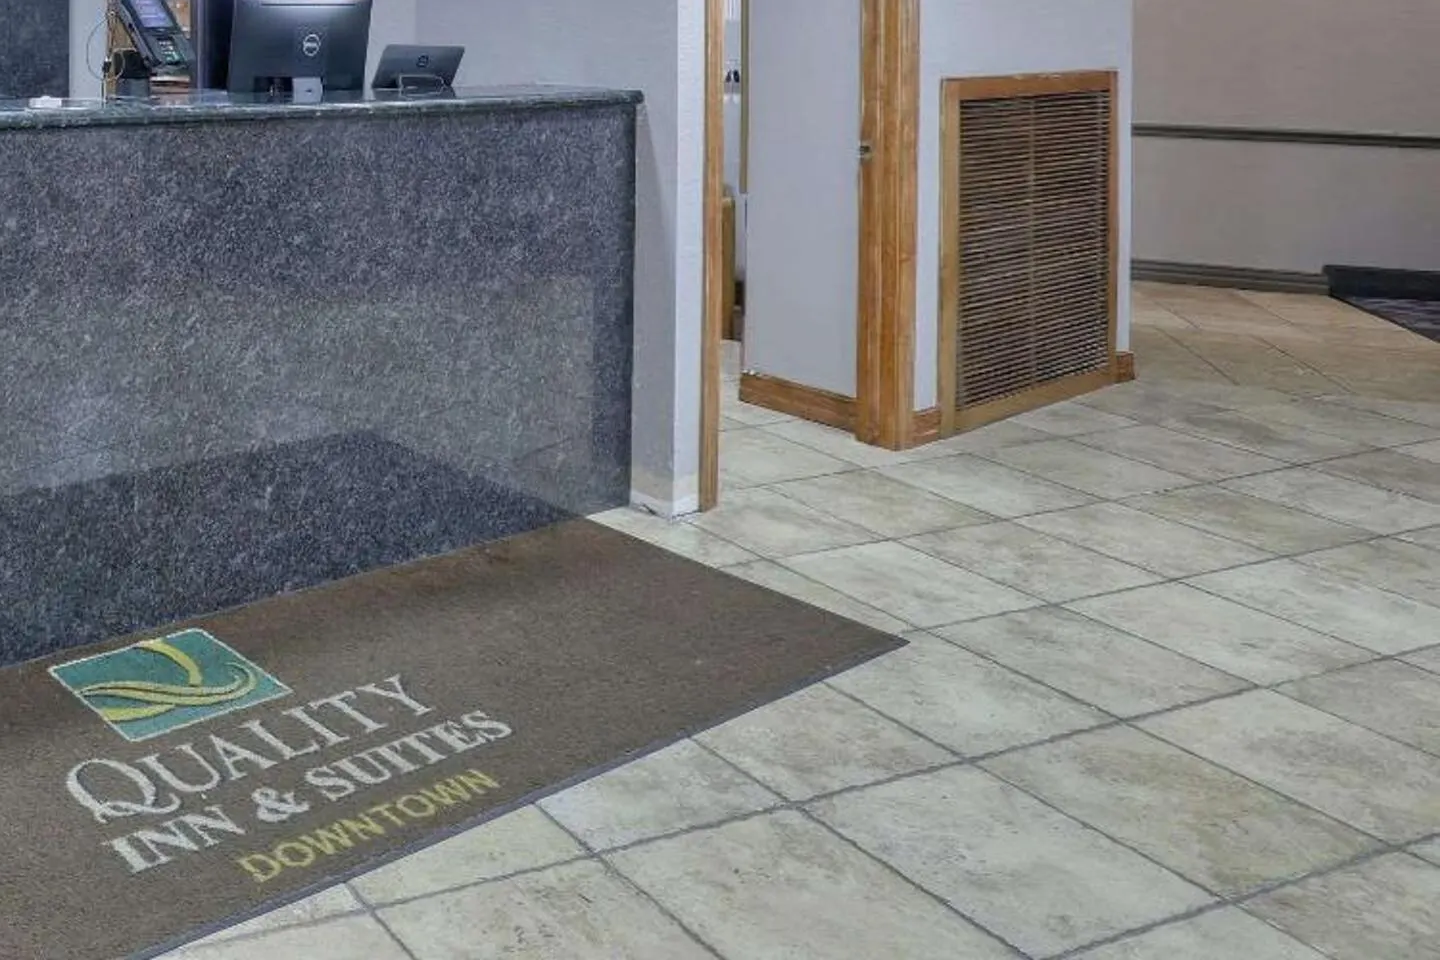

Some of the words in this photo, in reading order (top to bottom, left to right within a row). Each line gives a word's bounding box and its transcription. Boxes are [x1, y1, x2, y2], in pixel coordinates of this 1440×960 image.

[67, 674, 432, 823] QUALITY
[103, 804, 246, 873] INN
[251, 787, 309, 823] &
[304, 709, 513, 801] SUITES
[235, 768, 501, 882] DOWNTOWN
